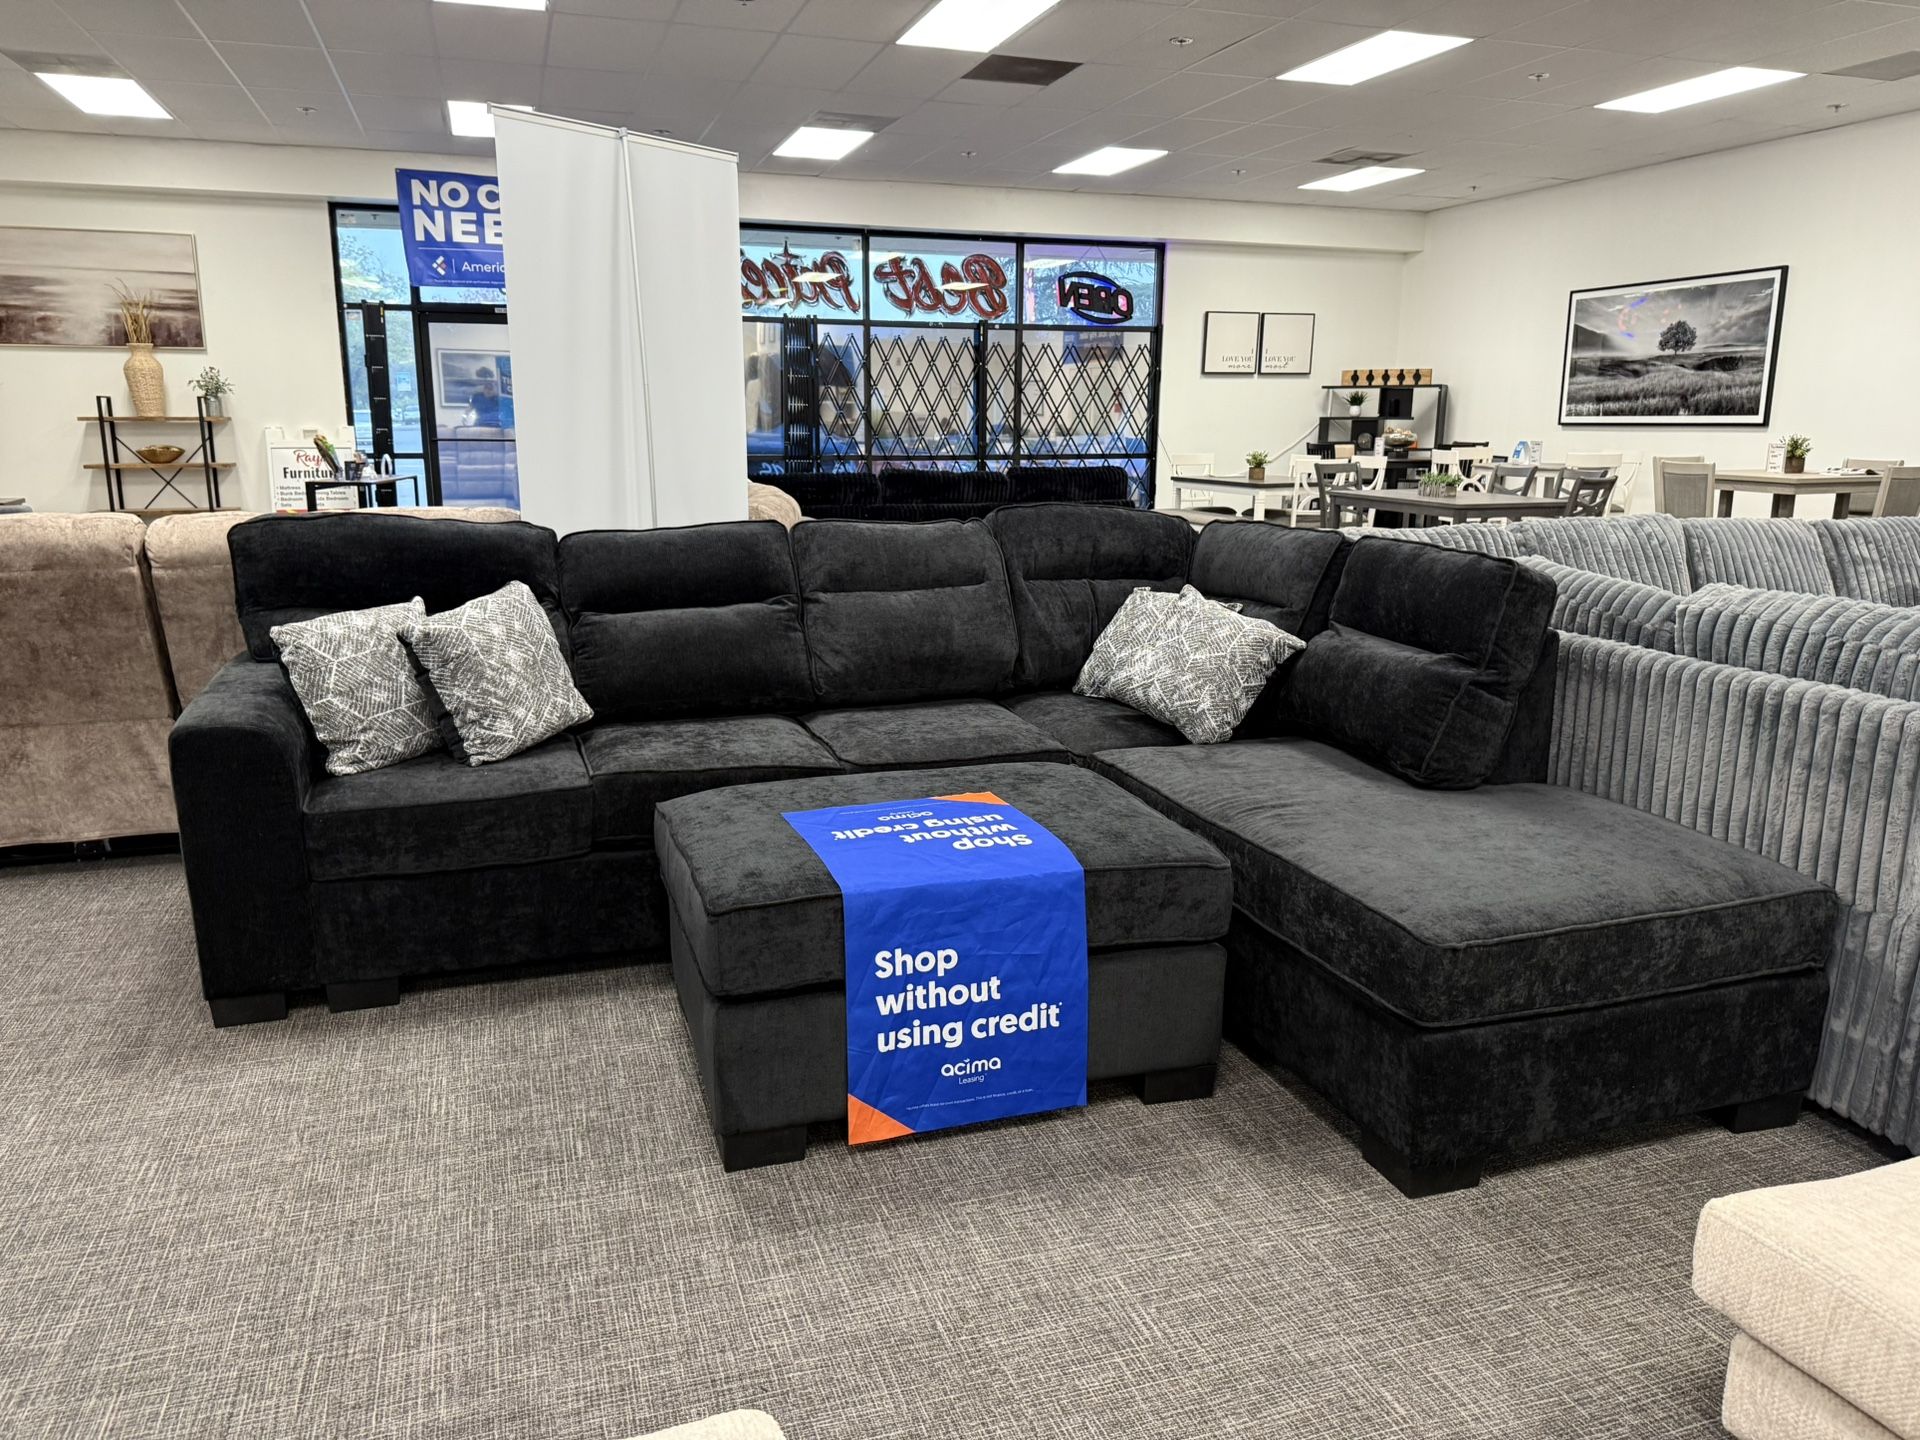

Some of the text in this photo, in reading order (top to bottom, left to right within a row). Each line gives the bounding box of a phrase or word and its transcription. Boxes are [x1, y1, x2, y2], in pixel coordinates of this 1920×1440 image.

[411, 179, 469, 208] NO
[293, 449, 323, 467] Ray
[283, 467, 337, 479] Furnitur
[877, 810, 933, 822] acima
[922, 813, 1004, 828] using
[899, 822, 1018, 843] without
[952, 833, 1033, 850] Shop
[874, 947, 958, 979] Shop
[875, 976, 1001, 1016] without
[877, 1019, 963, 1053] using
[941, 1056, 1001, 1077] acima
[958, 1073, 985, 1085] Leasing
